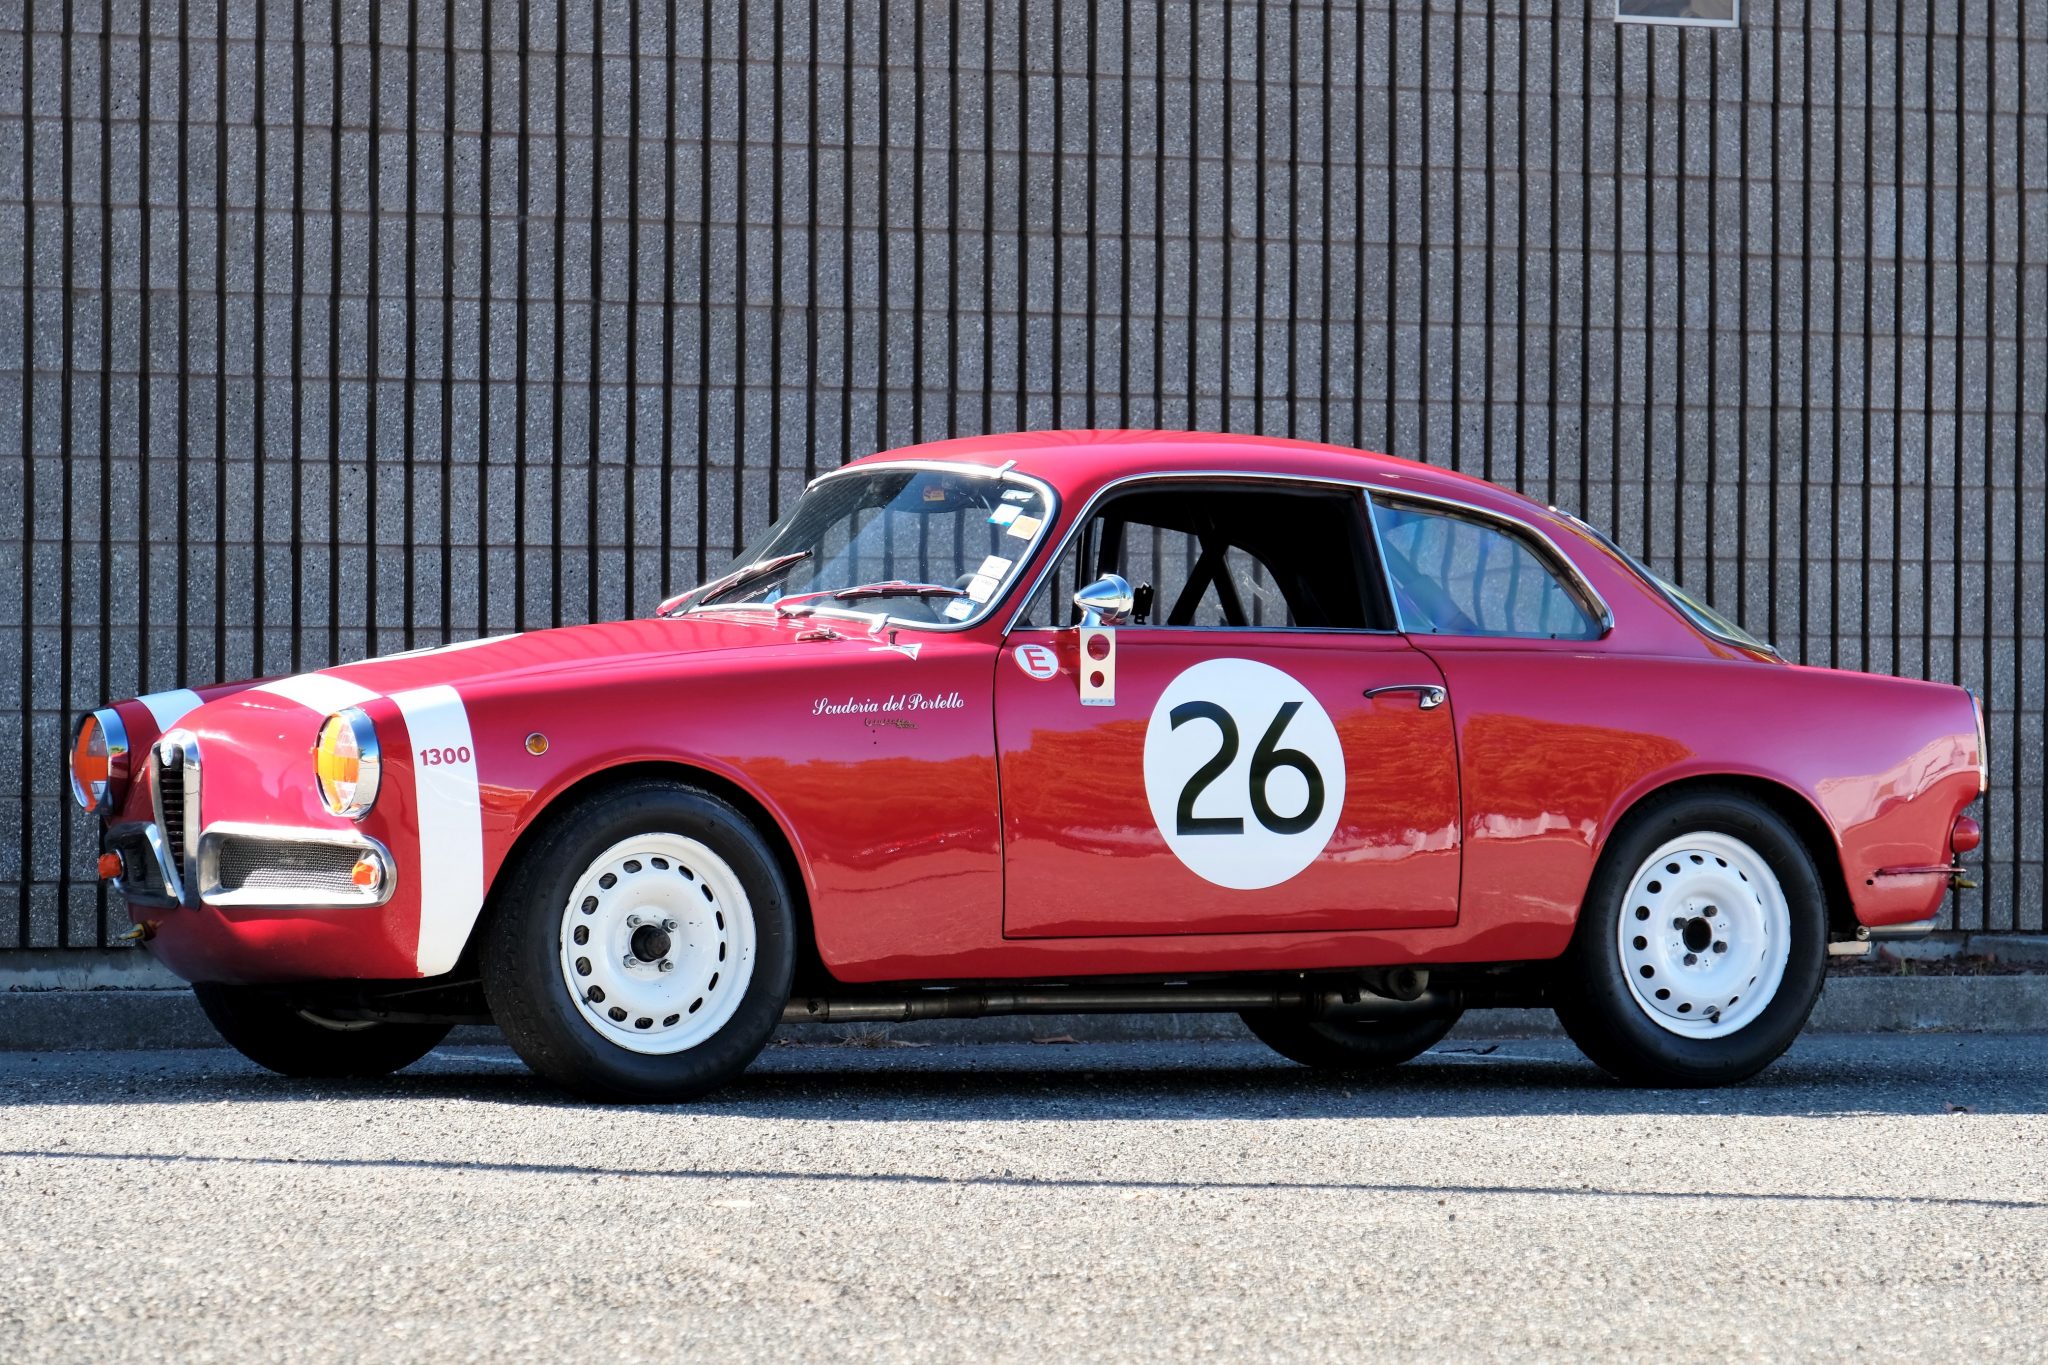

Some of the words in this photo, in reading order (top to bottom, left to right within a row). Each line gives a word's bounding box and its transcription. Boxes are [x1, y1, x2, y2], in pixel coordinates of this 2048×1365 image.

[1023, 648, 1050, 671] E
[812, 697, 878, 715] Scuderia
[882, 694, 905, 711] del
[908, 692, 964, 710] Portello
[420, 746, 471, 766] 1300
[1169, 700, 1325, 835] 26
